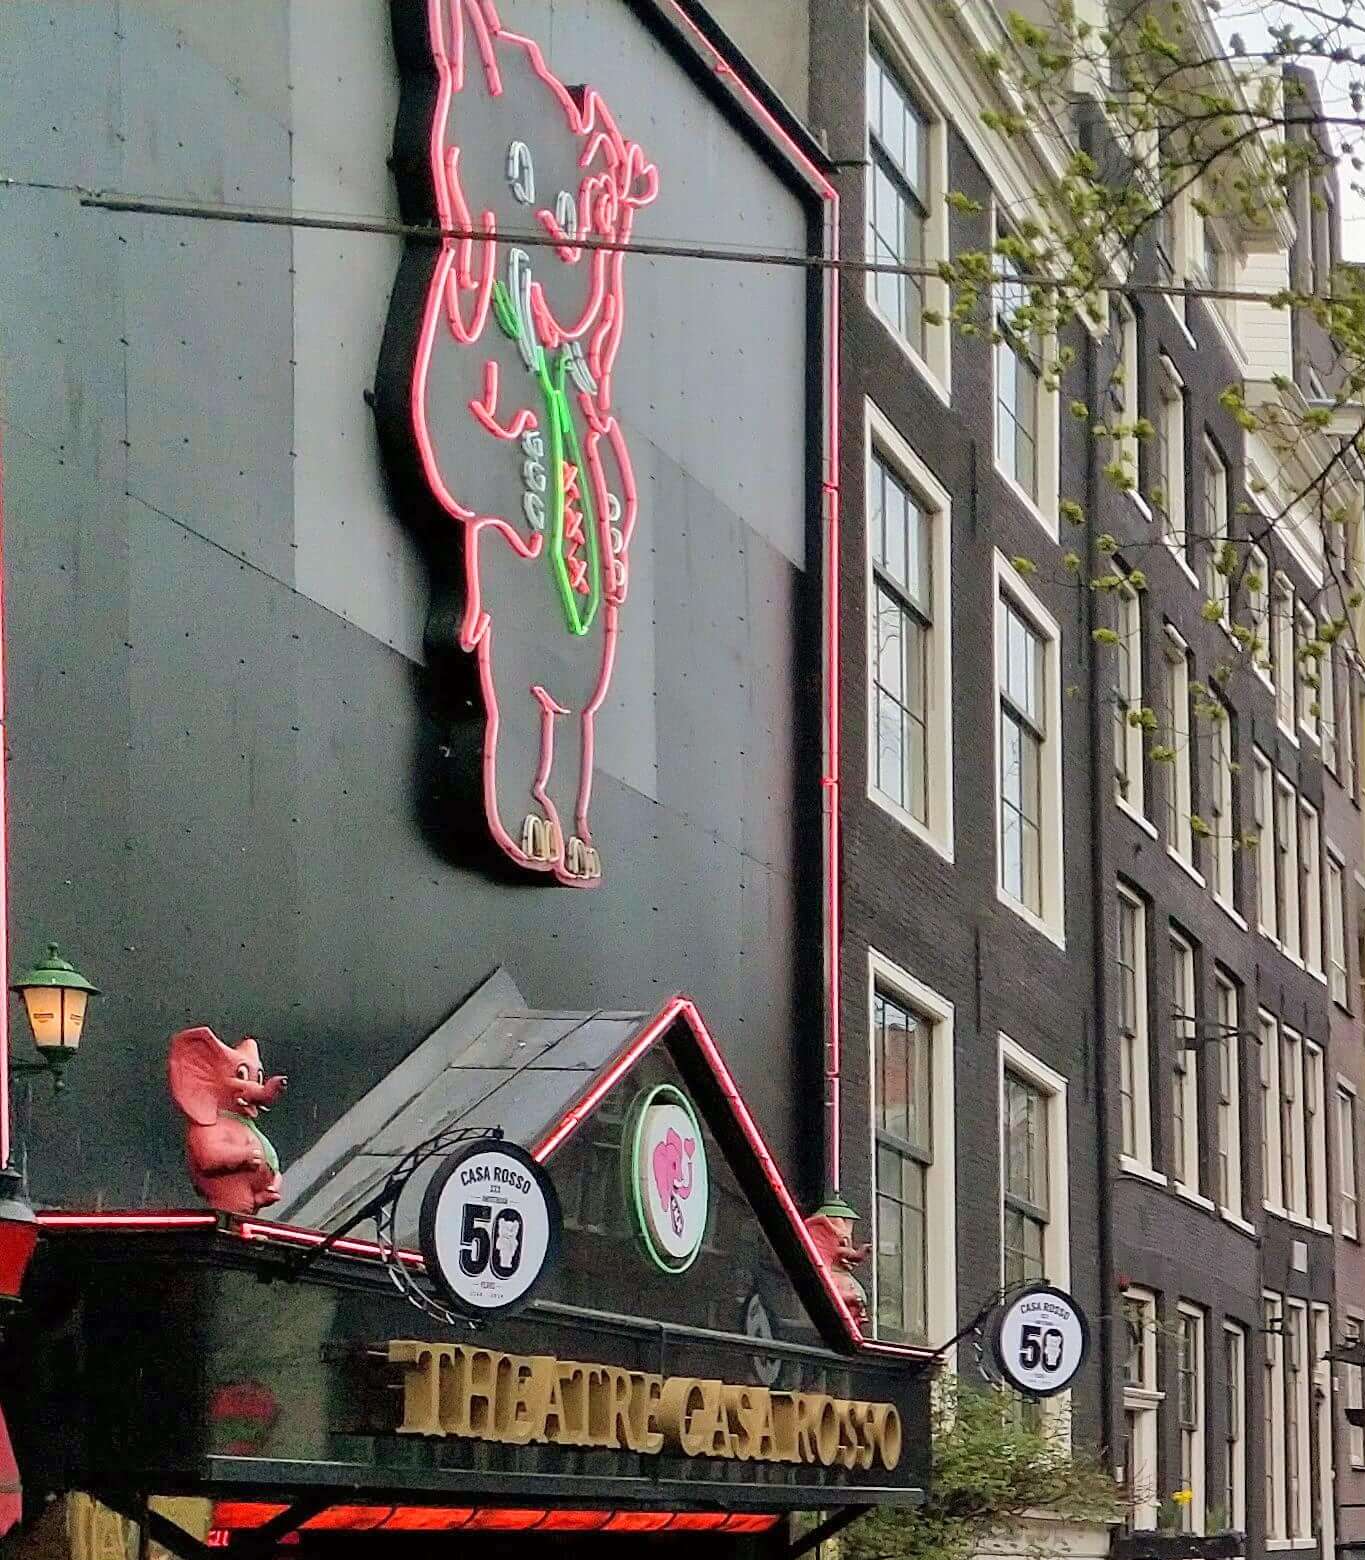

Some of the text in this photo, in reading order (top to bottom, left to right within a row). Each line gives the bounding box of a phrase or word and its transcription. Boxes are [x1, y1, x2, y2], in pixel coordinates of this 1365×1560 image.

[460, 1166, 531, 1194] CASA ROSSO
[459, 1203, 524, 1280] 50
[1020, 1302, 1071, 1320] CASA ROSSO
[1019, 1324, 1064, 1374] 50
[389, 1340, 902, 1471] THEATRE CASA ROSSO
